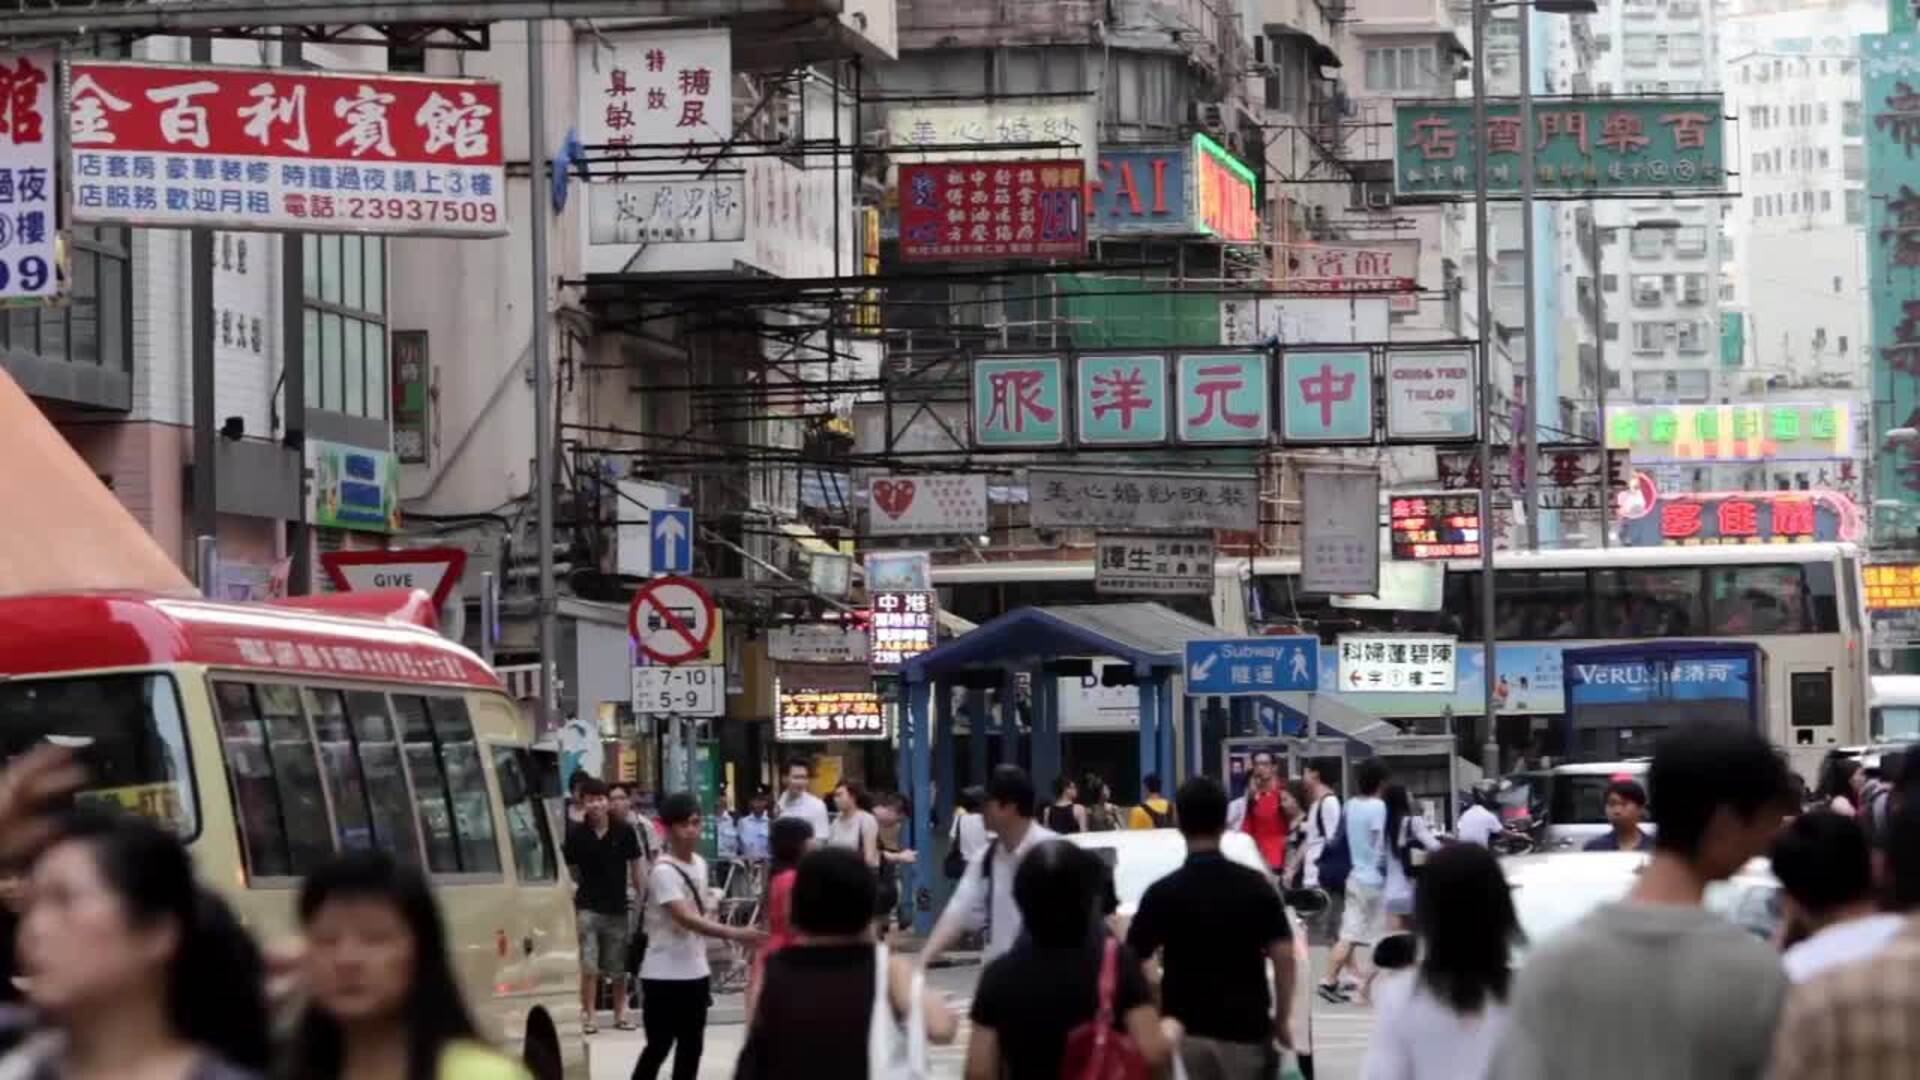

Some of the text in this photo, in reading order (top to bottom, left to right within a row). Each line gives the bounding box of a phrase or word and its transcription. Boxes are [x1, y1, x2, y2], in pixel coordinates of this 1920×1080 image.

[72, 74, 492, 158] 金百利賓館
[373, 574, 413, 587] GIVE
[1220, 644, 1284, 661] Subway
[660, 670, 706, 685] 7-10
[660, 691, 697, 707] 5-9
